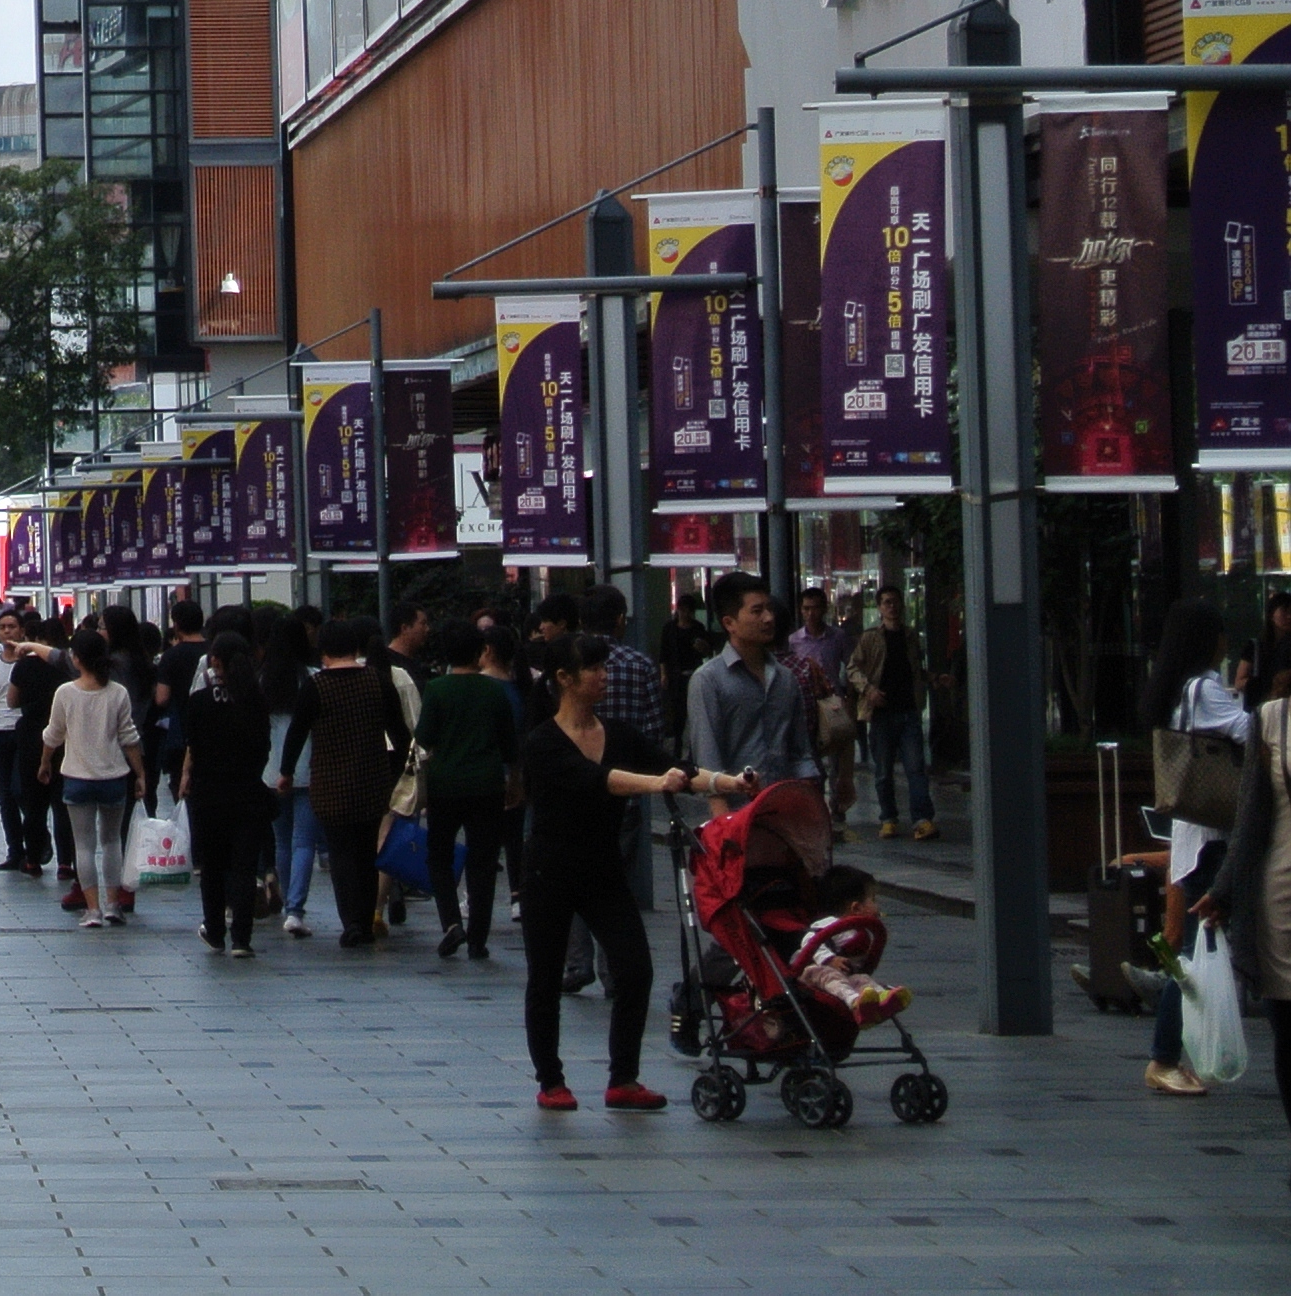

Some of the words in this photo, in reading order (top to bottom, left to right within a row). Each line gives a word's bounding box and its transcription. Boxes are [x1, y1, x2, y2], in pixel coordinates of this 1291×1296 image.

[912, 213, 933, 418] 天一广场刷广发信用卡
[560, 371, 576, 515] 天一广场刷广发信用卡
